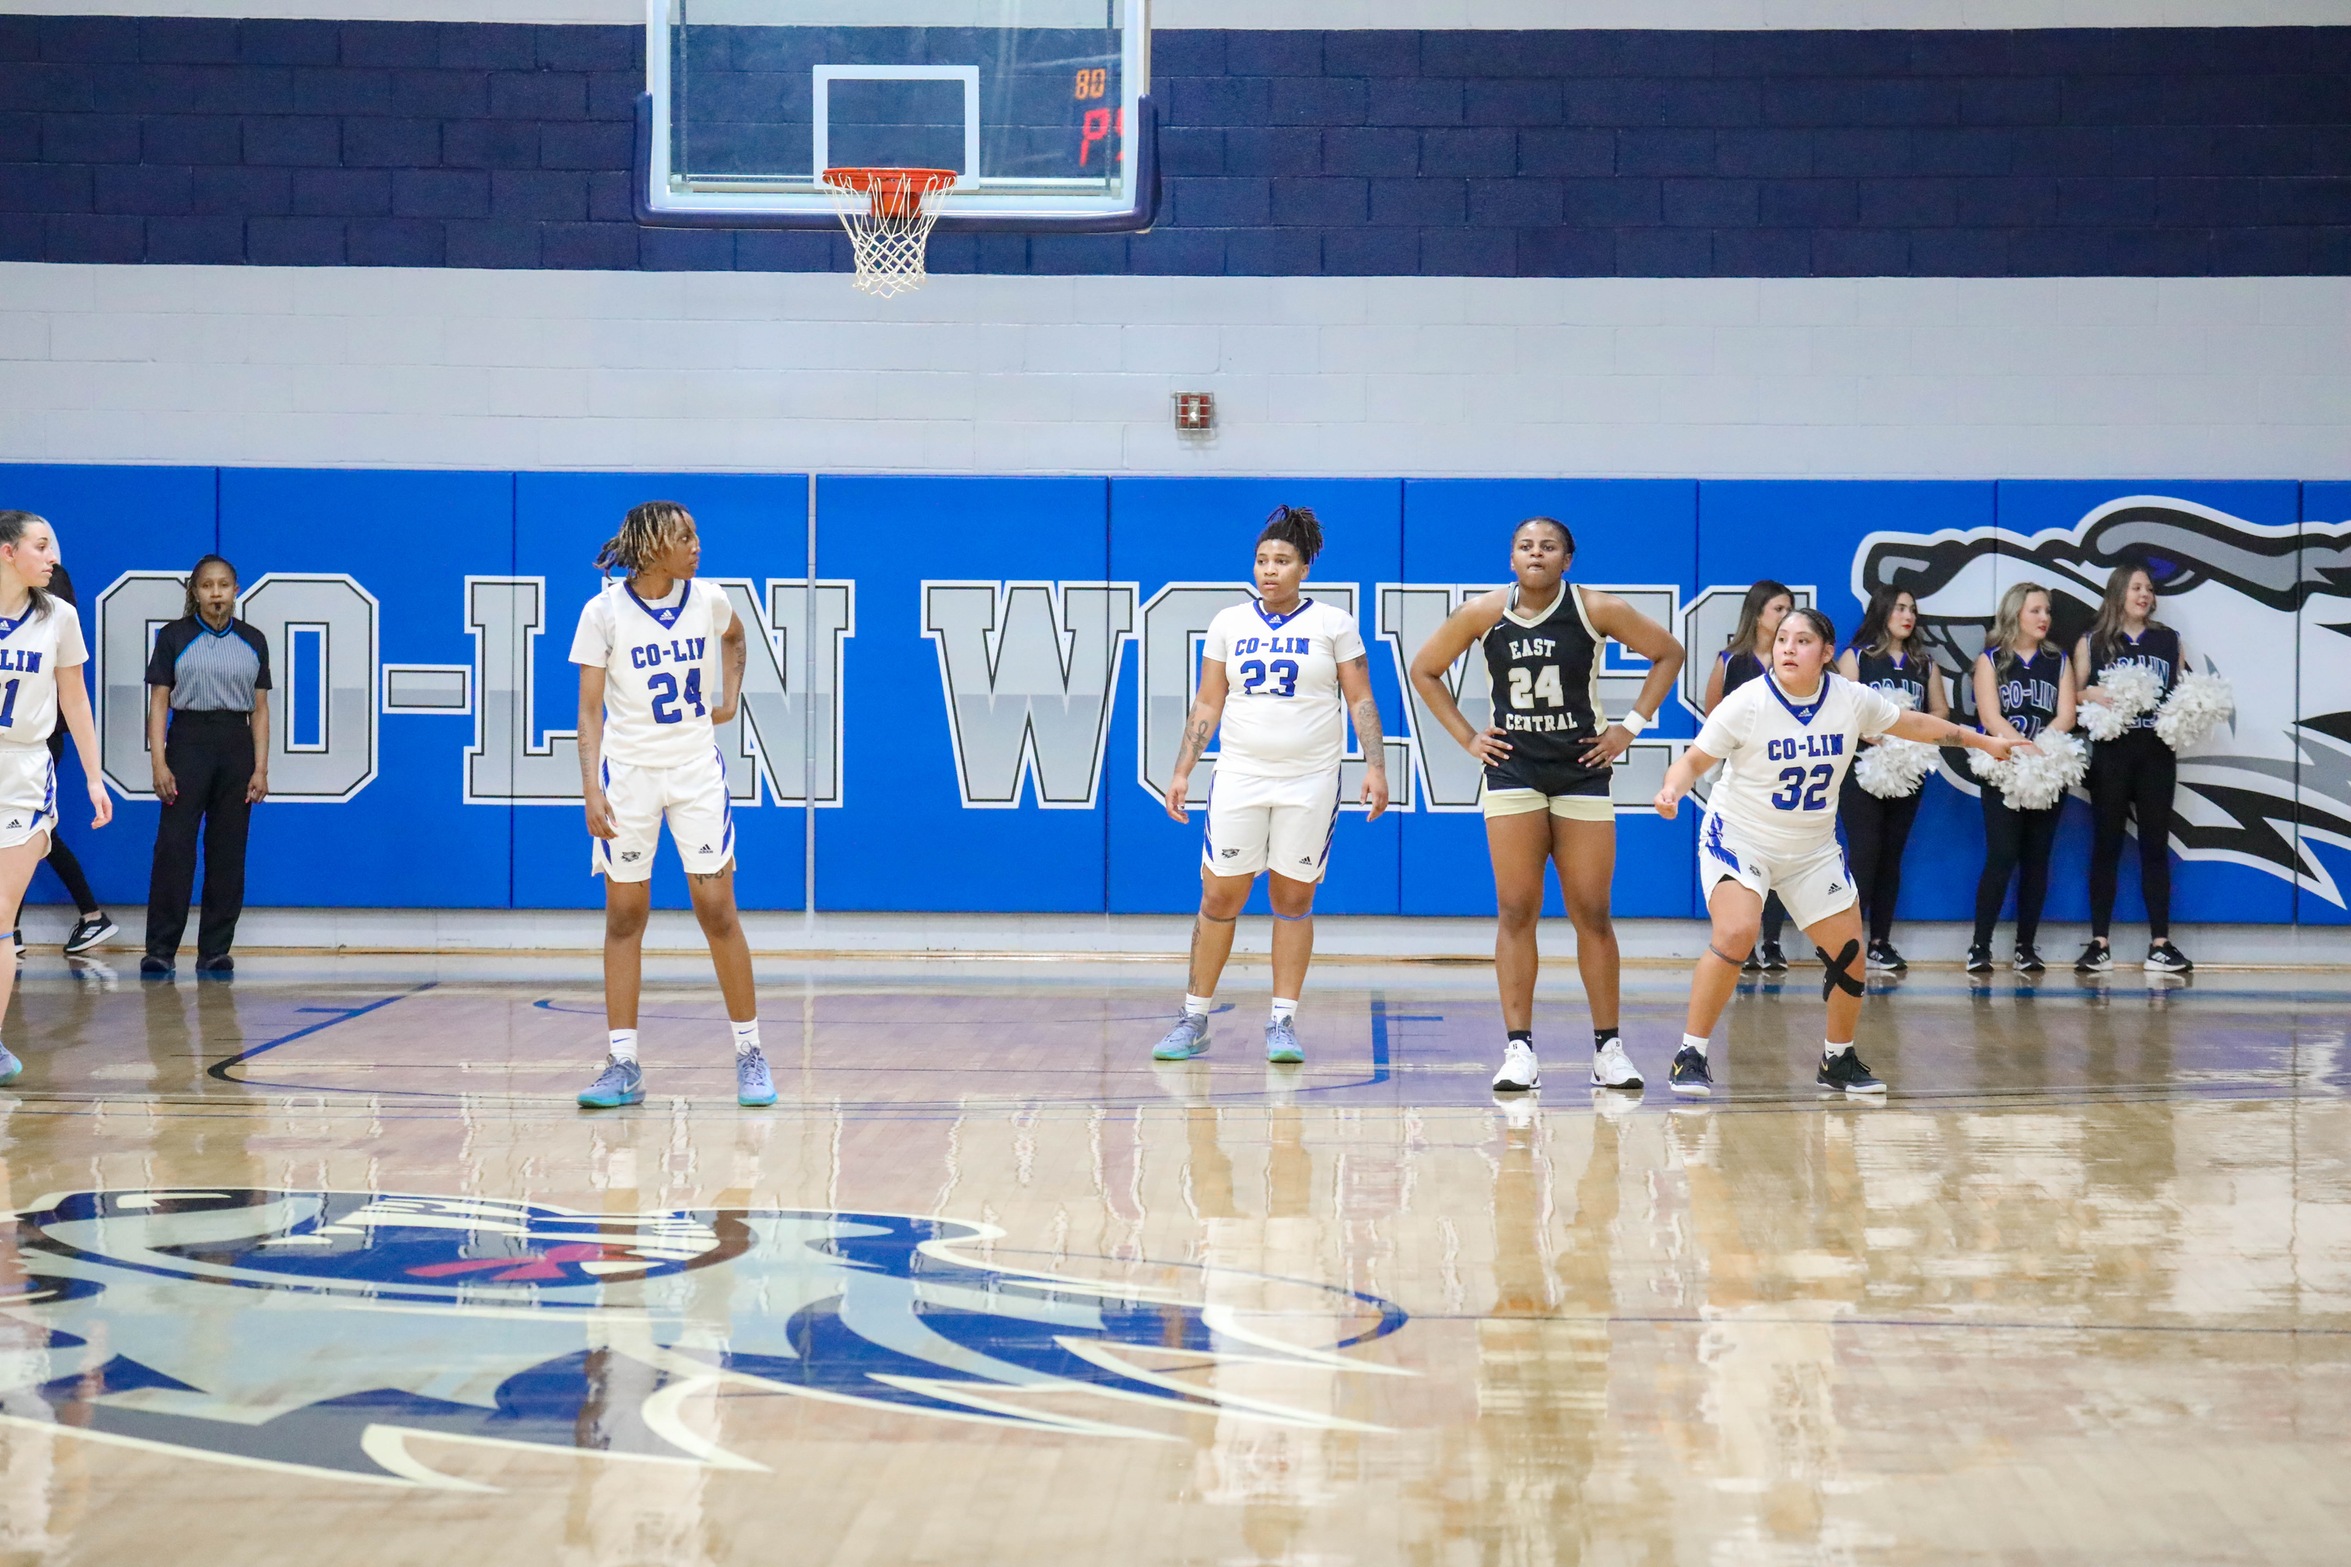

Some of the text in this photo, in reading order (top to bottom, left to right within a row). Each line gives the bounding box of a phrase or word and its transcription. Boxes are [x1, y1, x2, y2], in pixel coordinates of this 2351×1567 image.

[1234, 637, 1310, 656] CO-LIN
[1508, 638, 1556, 660] EAST
[0, 649, 43, 674] LIN
[1240, 659, 1299, 697] 23
[1507, 664, 1564, 709] 24
[647, 668, 706, 724] 24
[1505, 712, 1578, 732] CENTRAL
[1767, 733, 1844, 761] CO-LIN
[1771, 763, 1834, 811] 32
